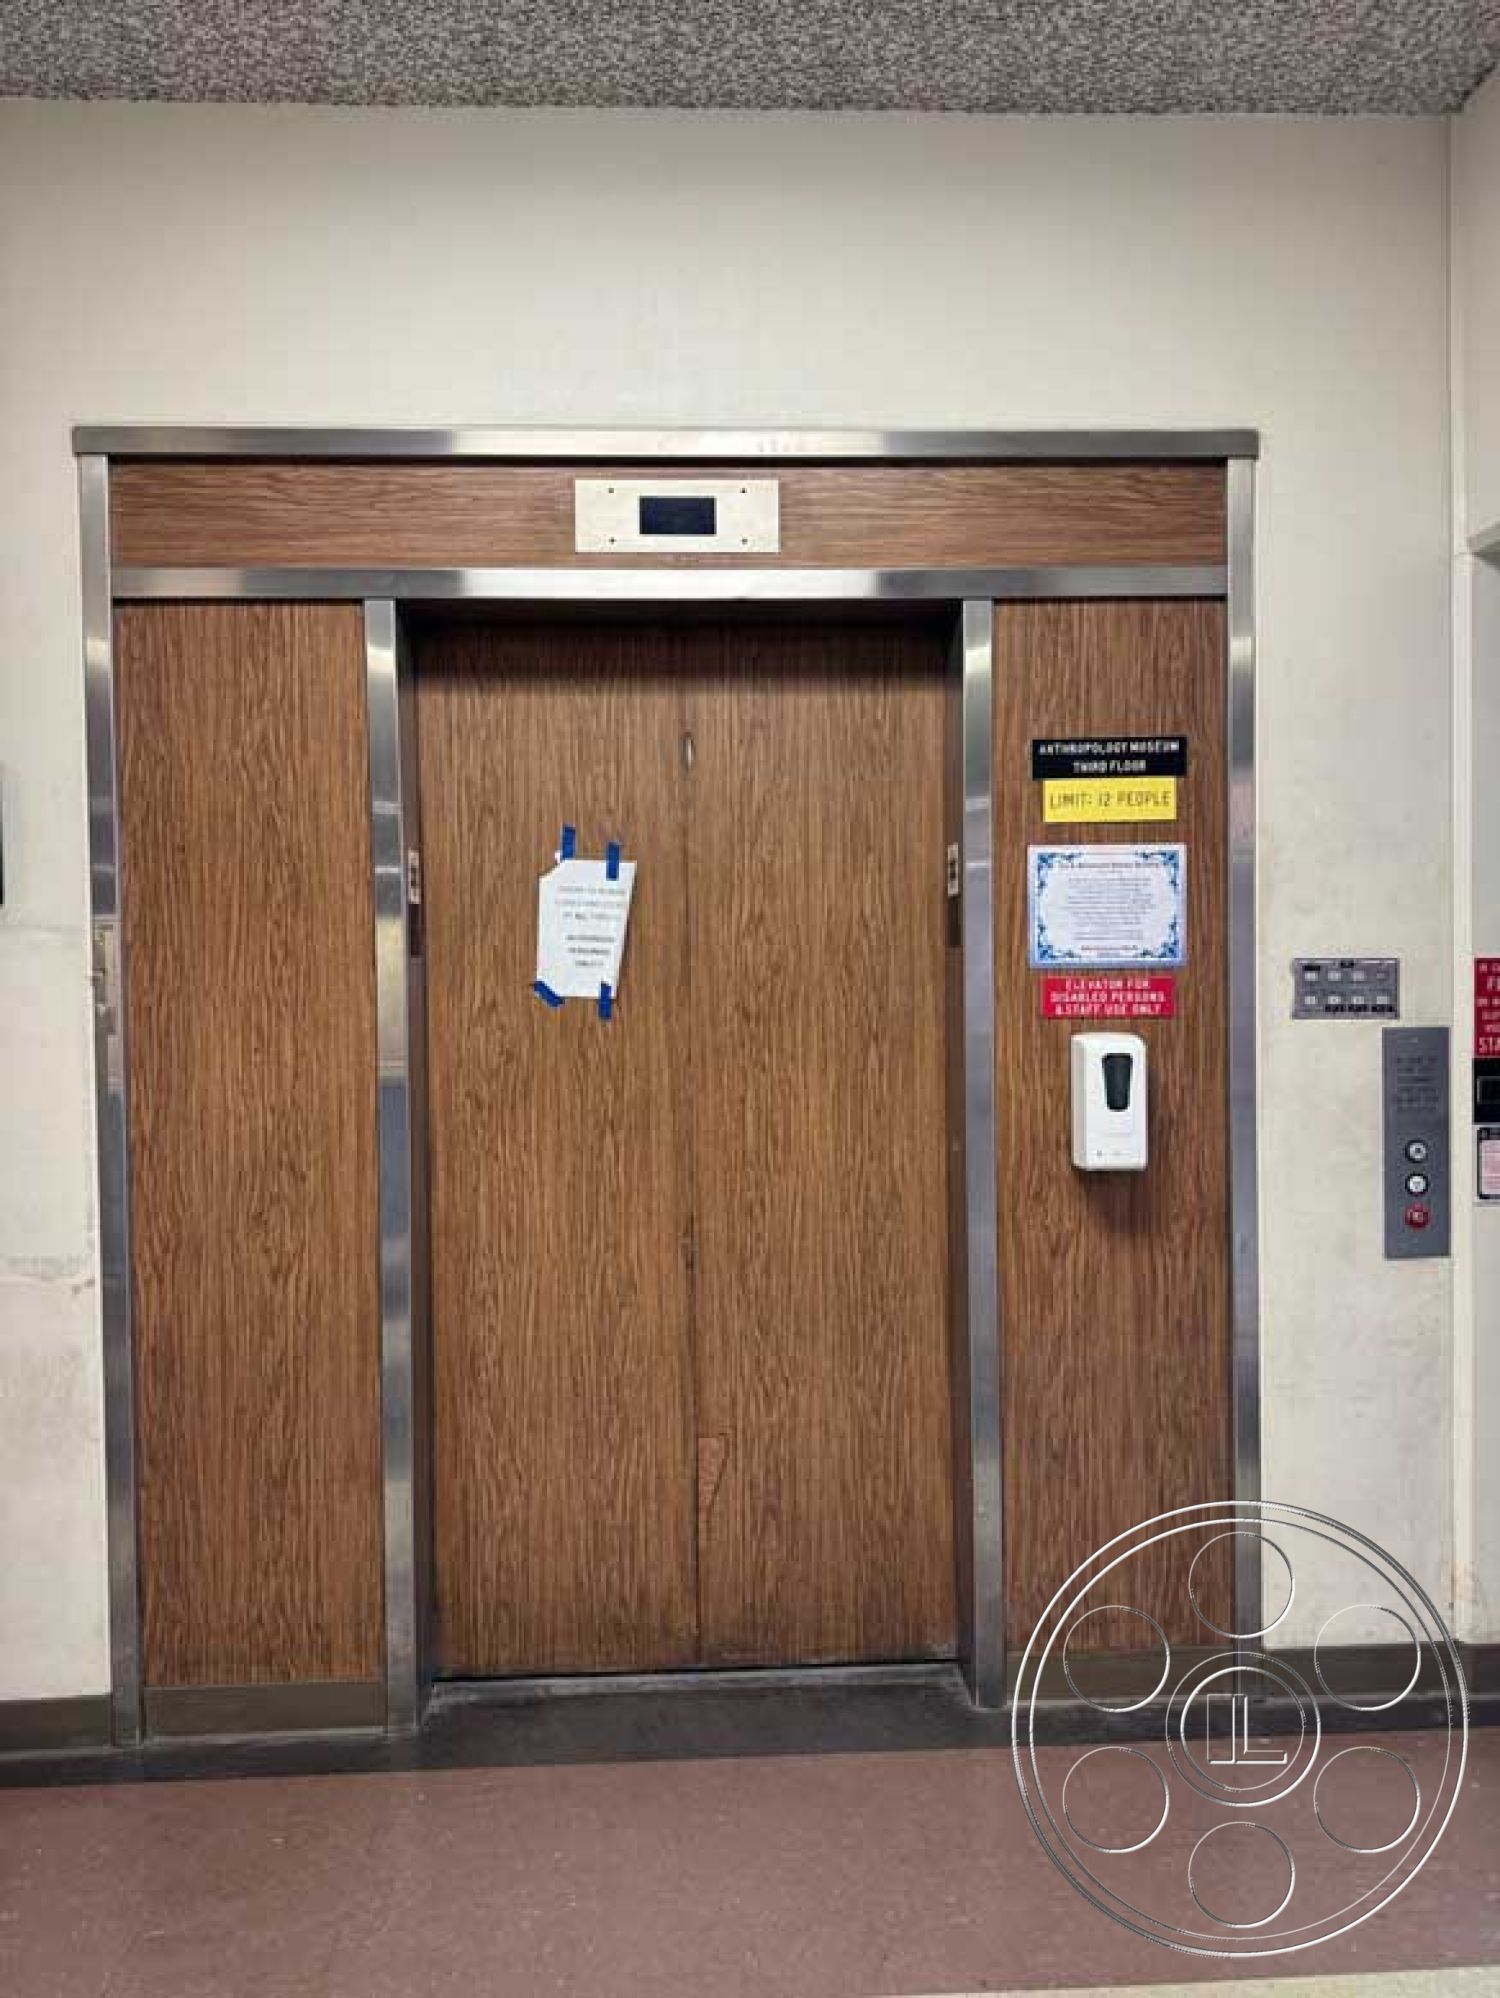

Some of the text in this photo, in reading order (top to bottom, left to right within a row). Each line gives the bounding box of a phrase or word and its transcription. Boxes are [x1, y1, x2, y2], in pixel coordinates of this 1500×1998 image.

[1130, 739, 1180, 753] MUSEUM
[1073, 759, 1147, 774] THIRD FLOOR
[1116, 790, 1172, 808] PEOPLE
[1065, 978, 1149, 990] ELEVATOR FOR
[1050, 990, 1165, 1003] DISABLED PERSONS
[1103, 1003, 1126, 1015] USE
[1131, 1003, 1161, 1015] ONLY
